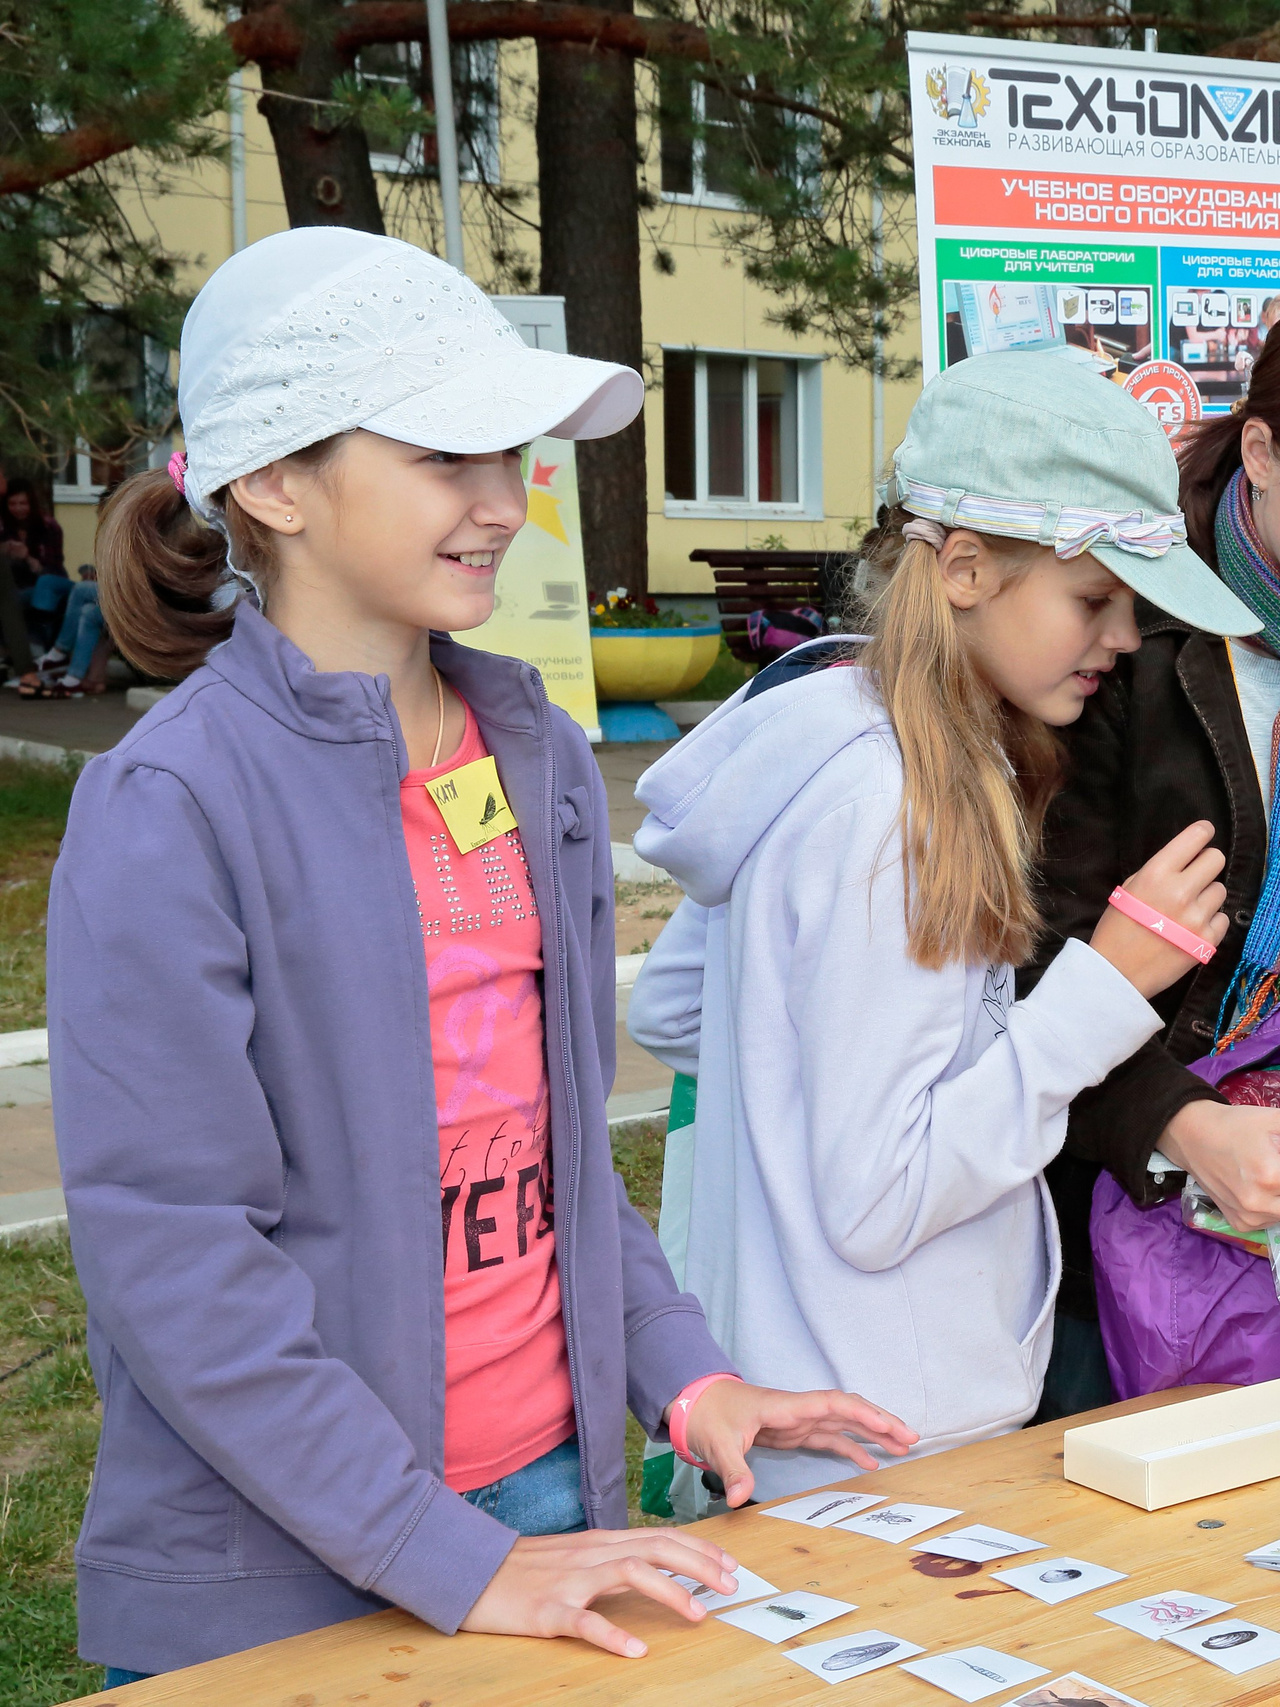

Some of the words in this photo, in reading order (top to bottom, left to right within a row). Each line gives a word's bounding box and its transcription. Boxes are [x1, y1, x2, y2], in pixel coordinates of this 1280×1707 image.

[937, 129, 986, 139] ЭКЗАМЕН
[932, 137, 991, 148] ТЕХНОЛАБ
[1007, 133, 1145, 157] РАЗВИВАЮЩАЯ
[1001, 178, 1115, 201] УЧЕБНОЕ
[1034, 203, 1133, 225] НОВОГО
[1137, 206, 1279, 230] ПОКОЛЕНИЯ
[959, 246, 1038, 262] ЦИФРОВЫЕ
[1040, 249, 1135, 263] ЛАБОРАТОРИИ
[1182, 254, 1251, 268] ЦИФРОВЫЕ
[1004, 260, 1032, 273] ДЛЯ
[1034, 260, 1094, 274] УЧИТЕЛЯ
[1197, 266, 1224, 280] ДЛЯ
[542, 671, 584, 681] сковье
